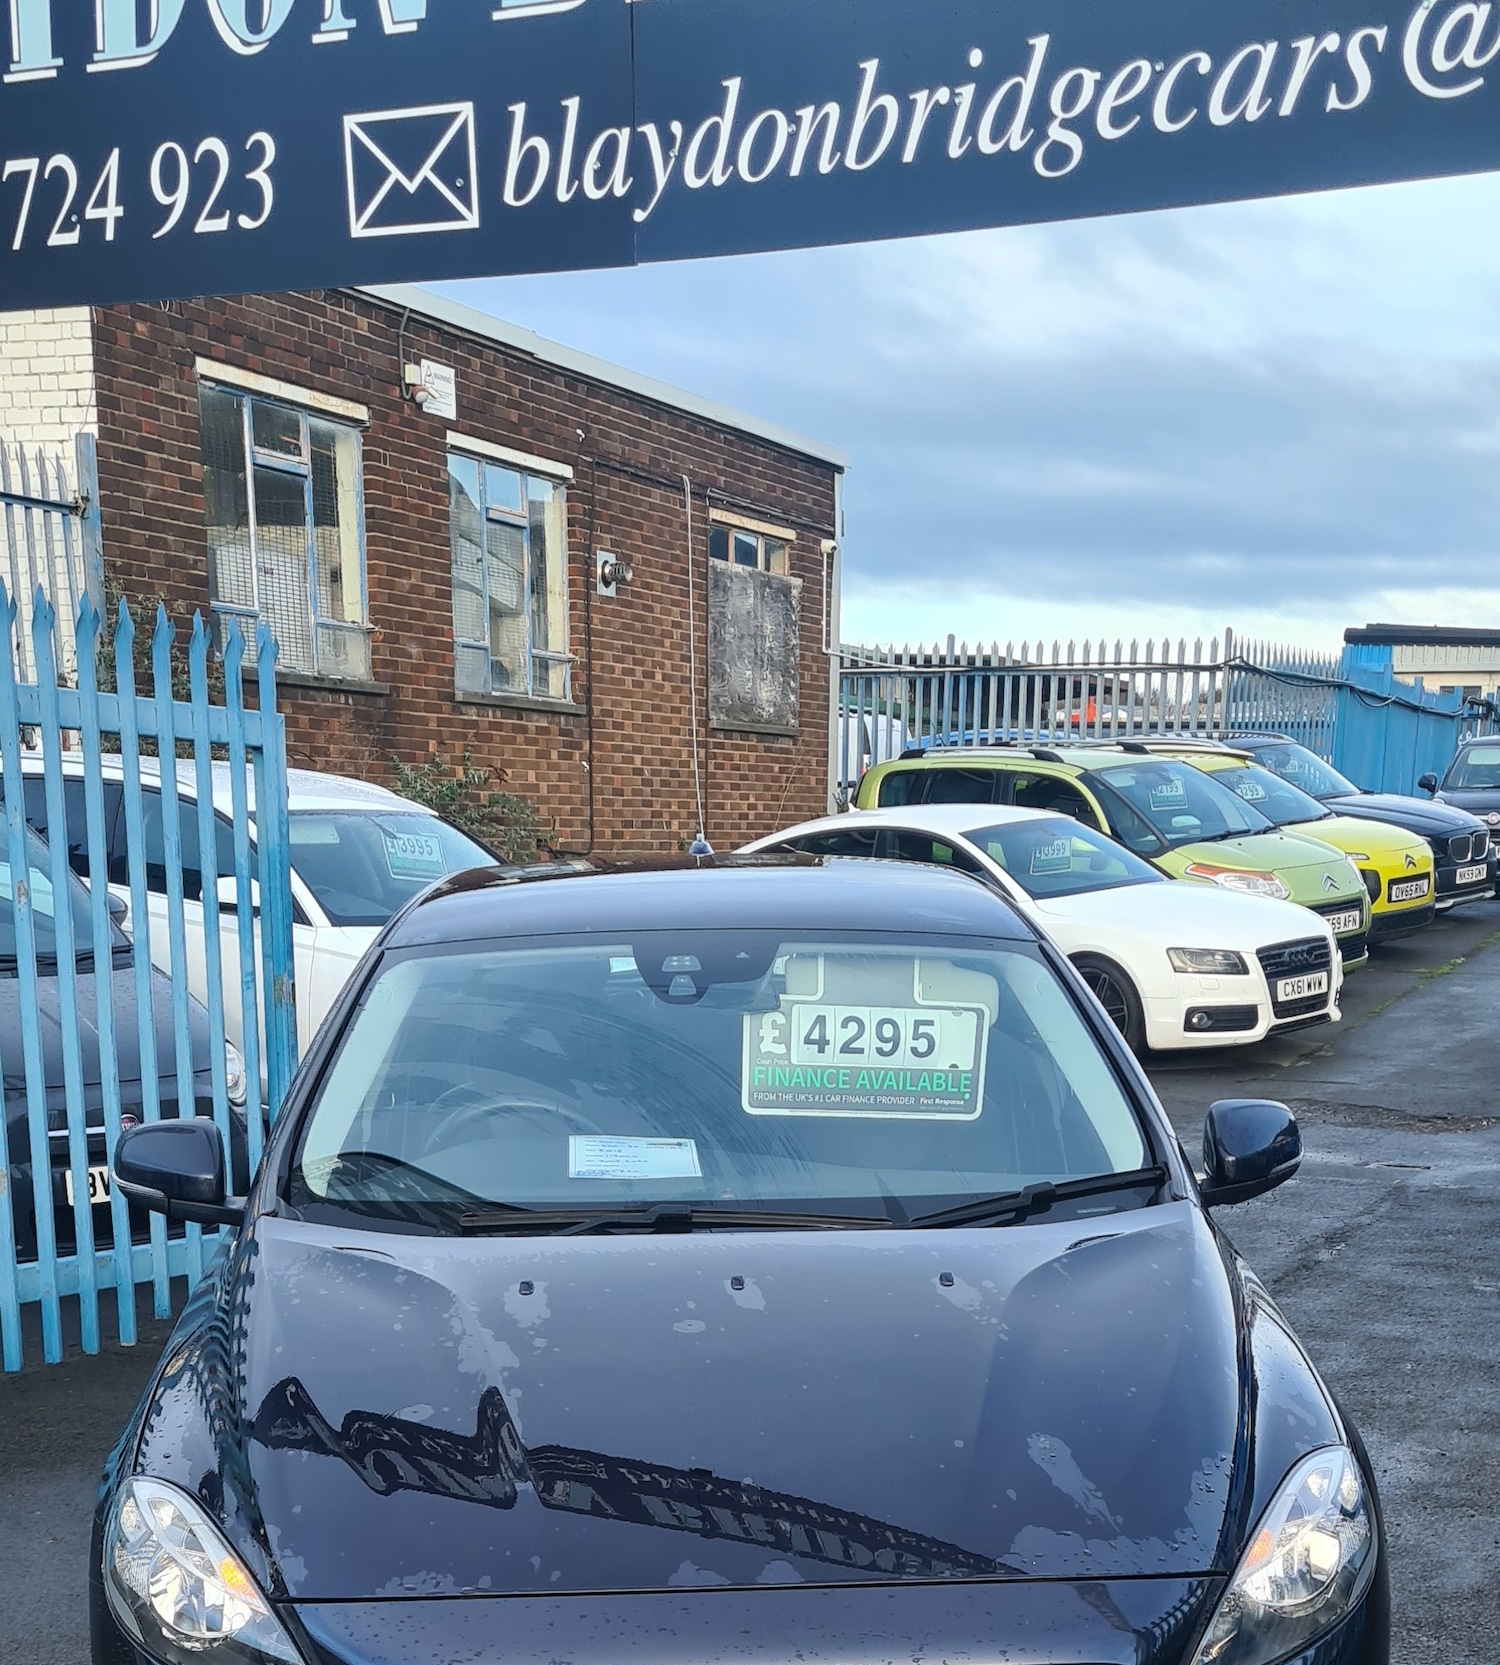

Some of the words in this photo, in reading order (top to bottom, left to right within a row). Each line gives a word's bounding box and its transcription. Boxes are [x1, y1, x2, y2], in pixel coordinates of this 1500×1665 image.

[2, 148, 125, 251] 724
[150, 131, 277, 239] 923
[399, 837, 433, 856] 3995
[803, 1014, 936, 1058] 4295
[753, 1066, 850, 1089] FINANCE
[856, 1069, 972, 1093] AVAILABLE
[753, 1092, 777, 1101] FROM
[778, 1093, 793, 1101] THE
[795, 1093, 814, 1102] UK'S
[825, 1094, 841, 1103] CAR
[842, 1095, 875, 1104] FINANCE
[876, 1095, 915, 1105] PROVIDER
